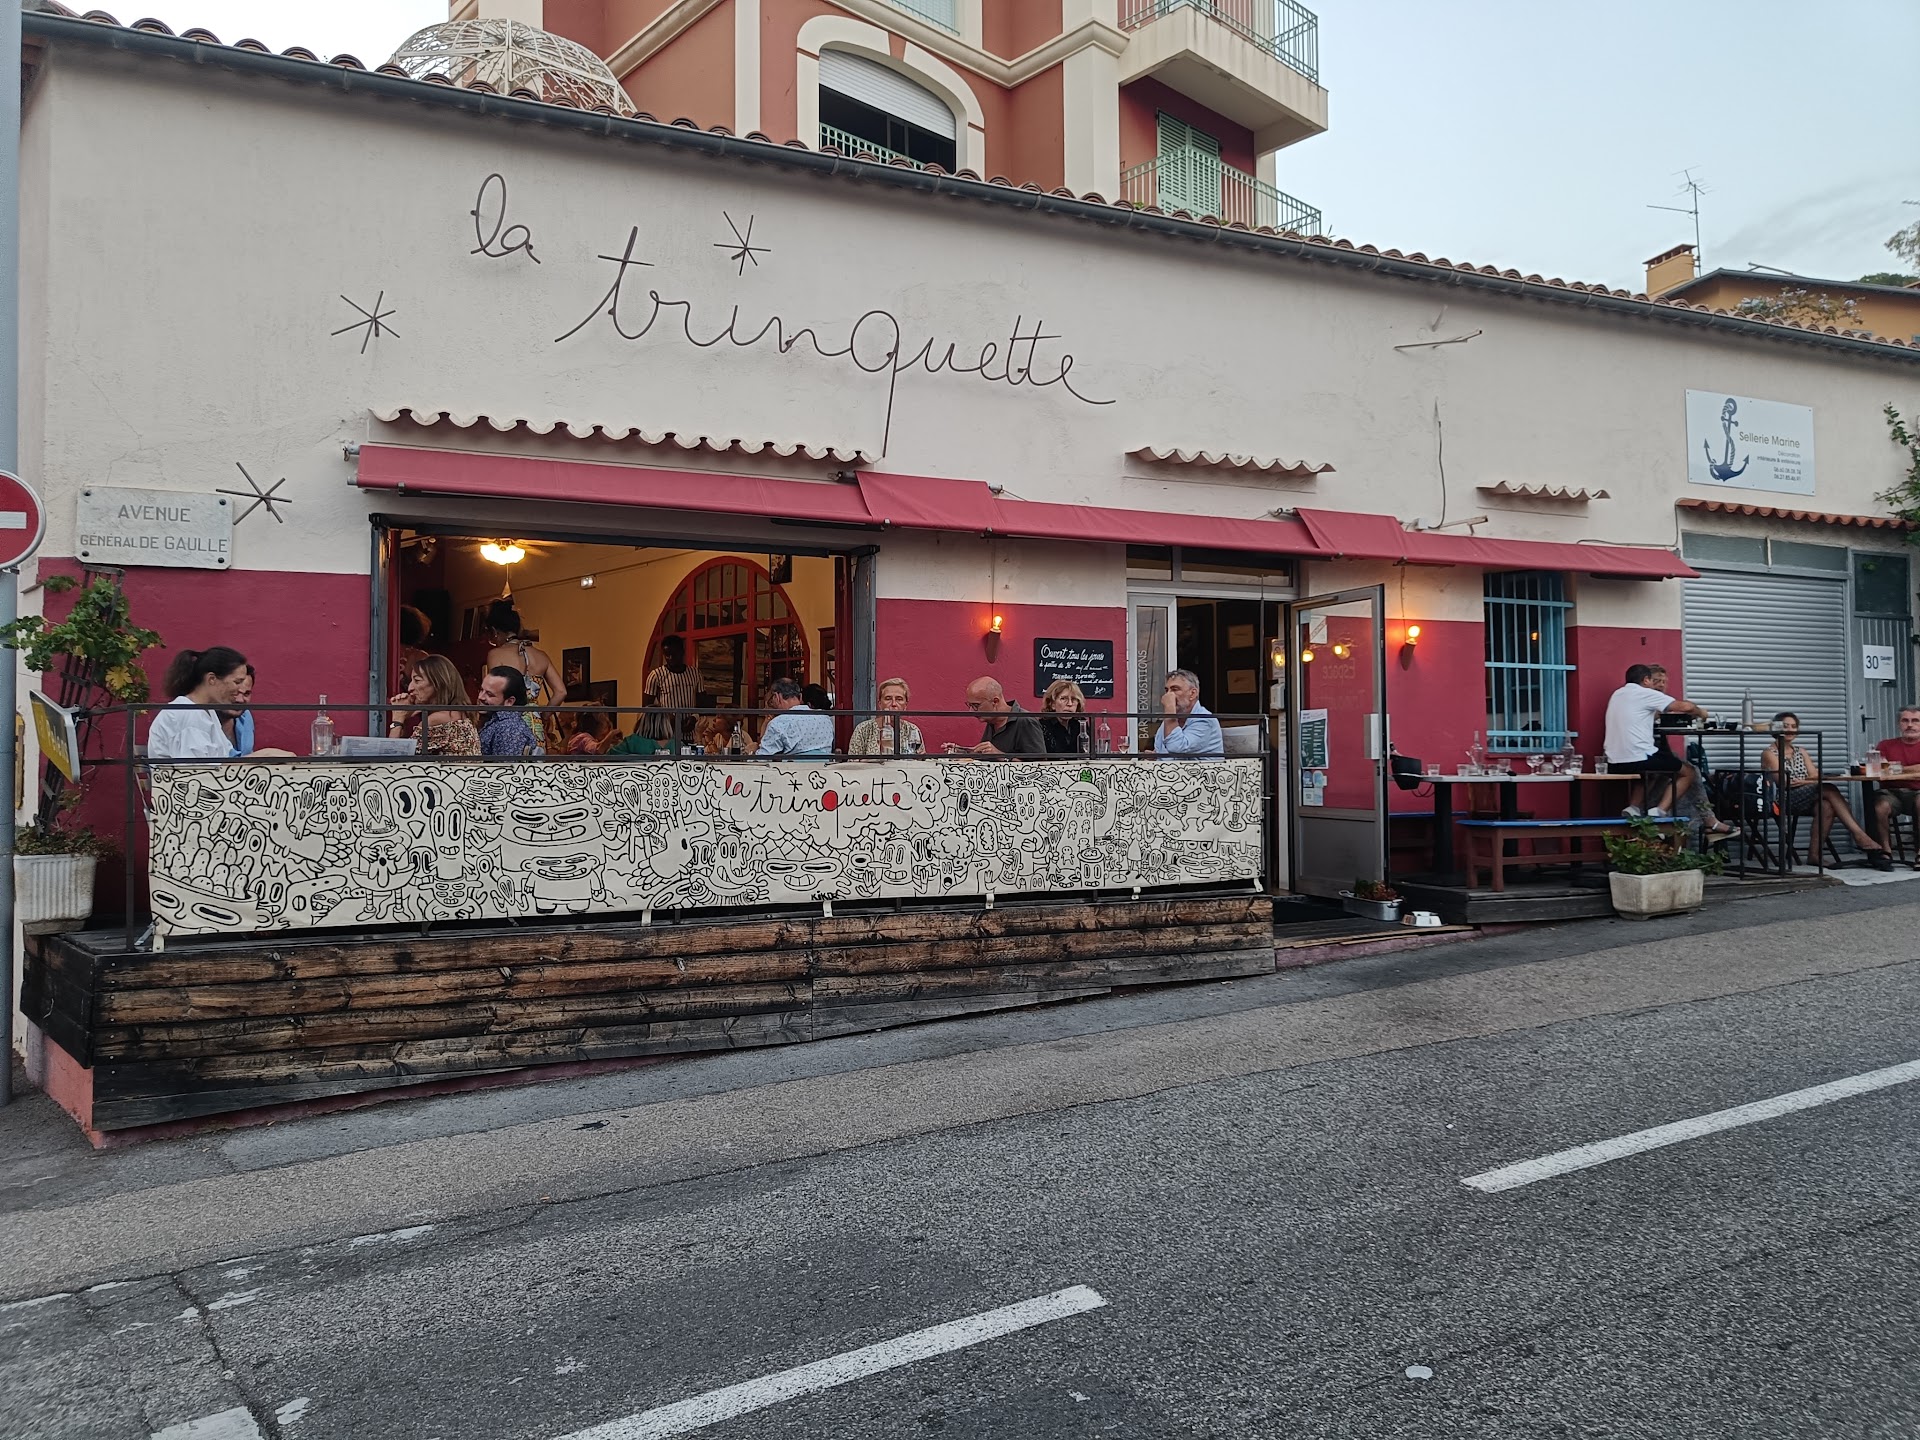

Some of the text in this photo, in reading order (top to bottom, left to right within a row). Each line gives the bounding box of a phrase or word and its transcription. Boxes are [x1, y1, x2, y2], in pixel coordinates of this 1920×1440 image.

[469, 173, 1117, 459] la trinquette
[1739, 431, 1800, 449] Sellerie Marine
[117, 504, 191, 523] AVENUE
[139, 536, 160, 549] DE
[164, 535, 228, 553] GAULLE
[1865, 655, 1879, 669] 30
[1138, 649, 1150, 739] BAR EXPOSITIONS
[721, 774, 913, 839] la trinquette
